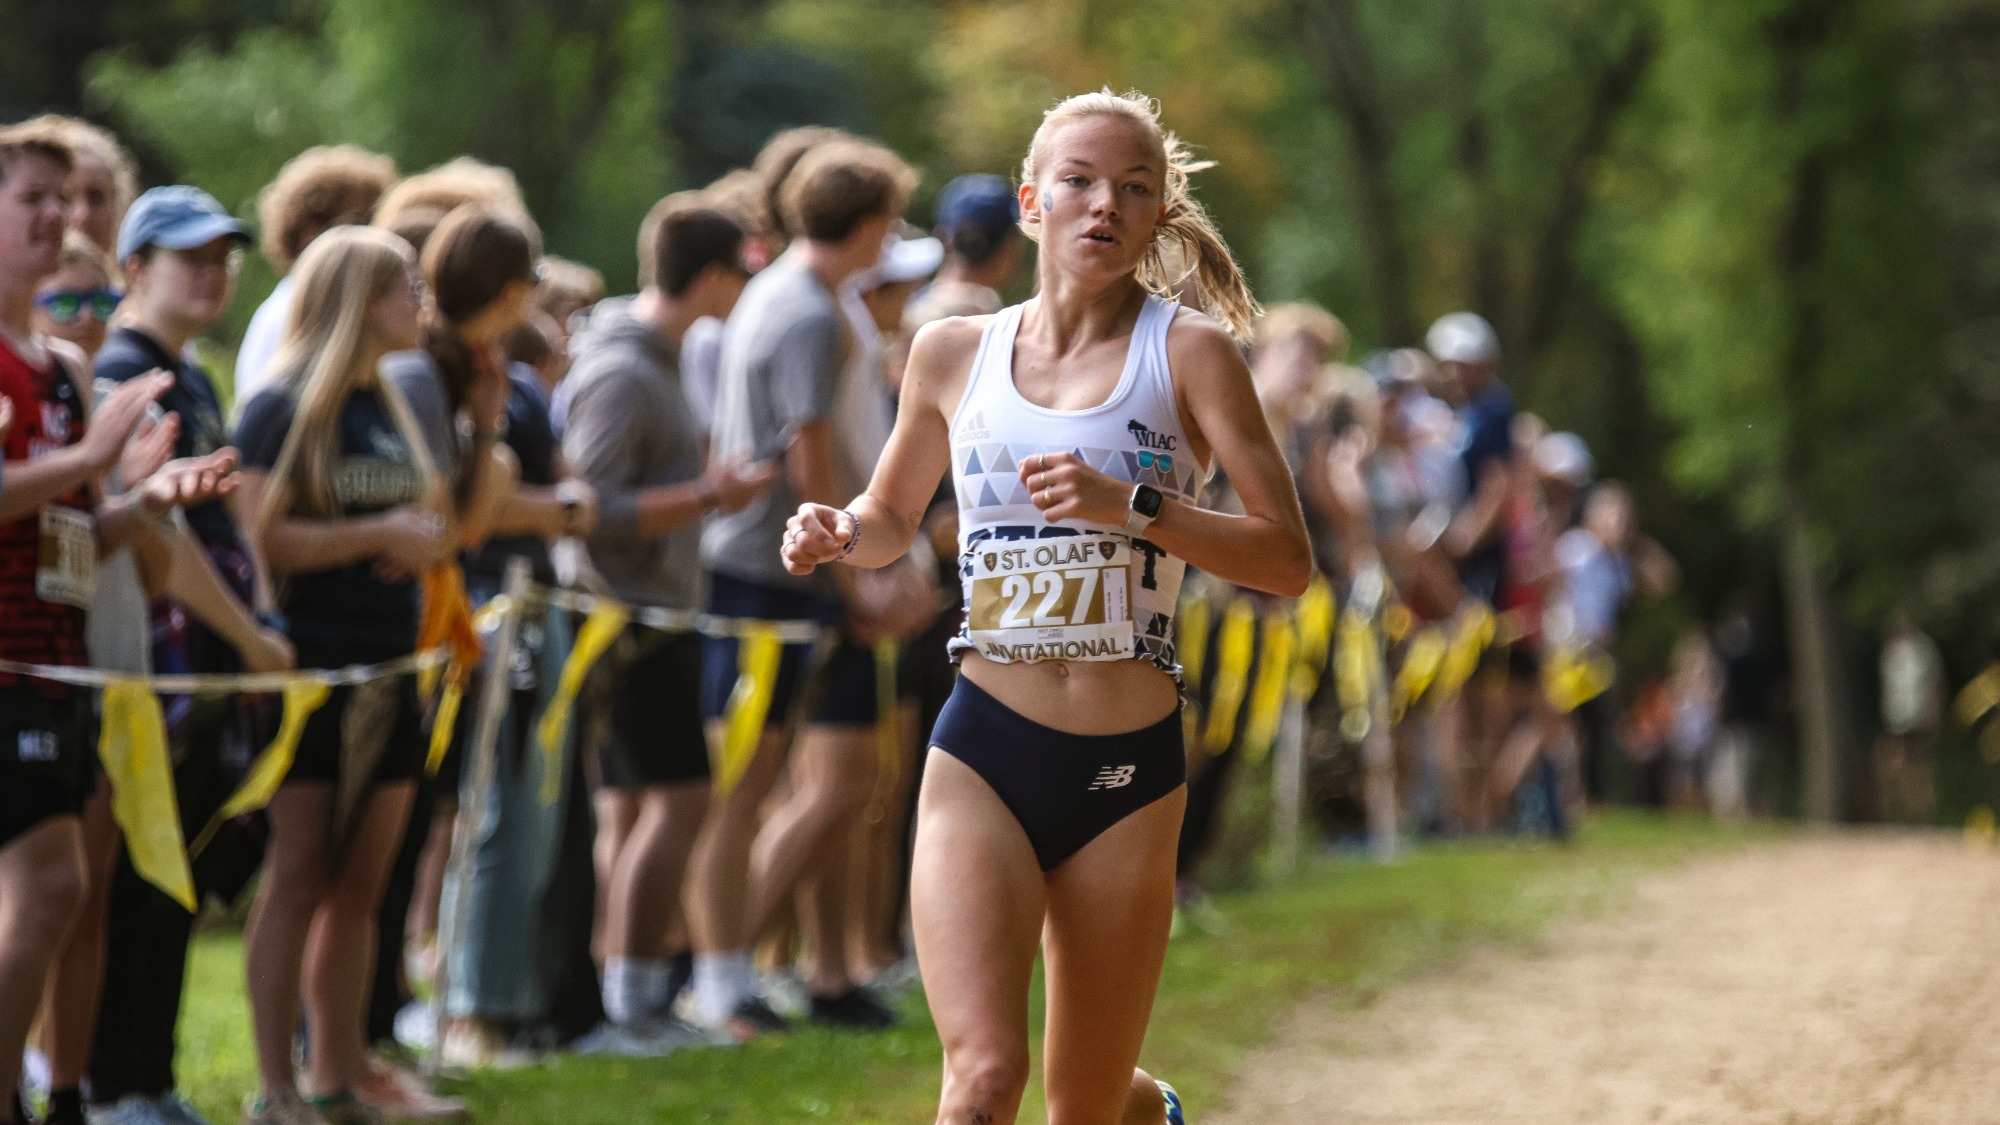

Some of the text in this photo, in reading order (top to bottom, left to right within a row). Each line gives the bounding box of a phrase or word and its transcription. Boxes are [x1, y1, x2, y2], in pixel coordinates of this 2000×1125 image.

[957, 430, 991, 443] adidas
[1134, 430, 1176, 451] WIAC
[1001, 541, 1095, 570] ST. OLAF
[1000, 568, 1099, 629] 227
